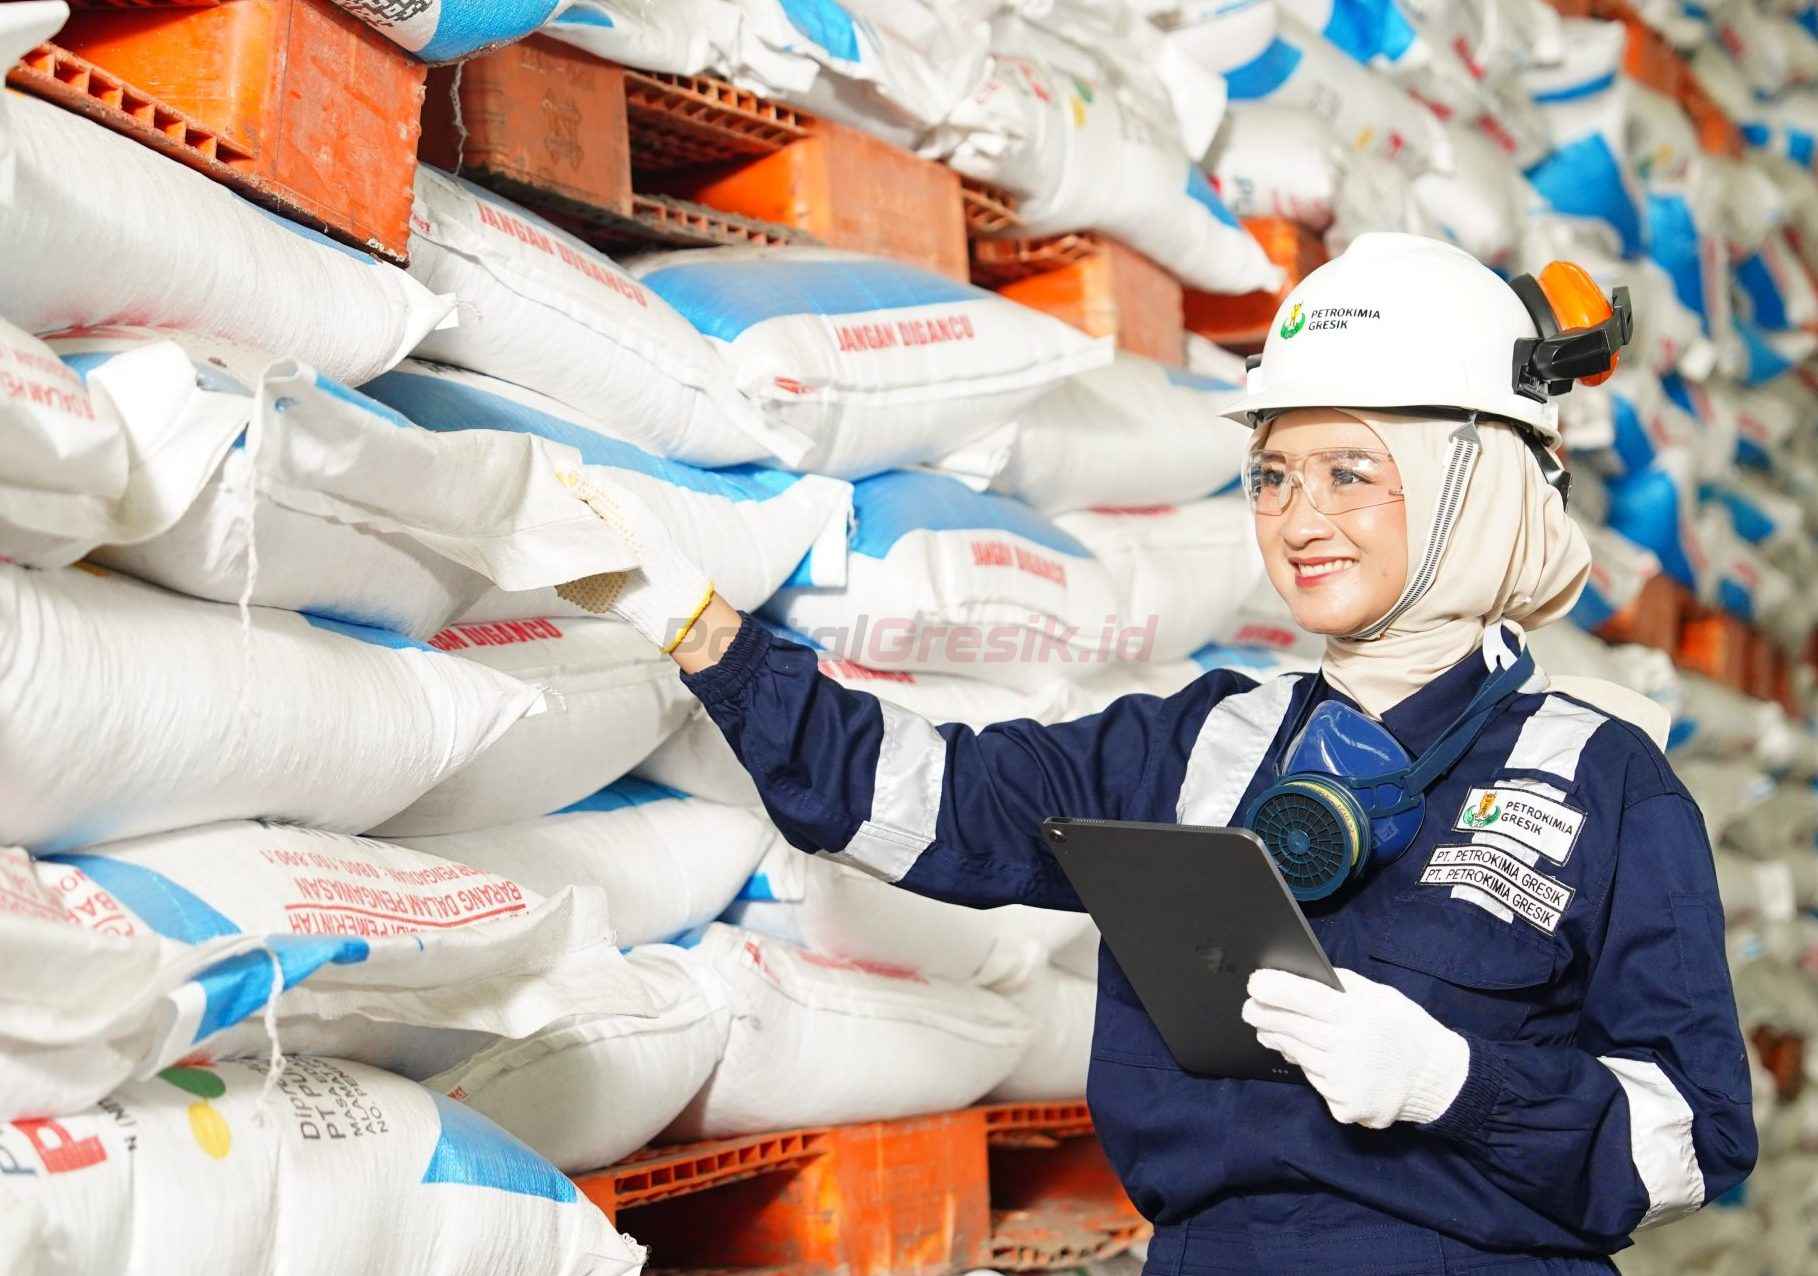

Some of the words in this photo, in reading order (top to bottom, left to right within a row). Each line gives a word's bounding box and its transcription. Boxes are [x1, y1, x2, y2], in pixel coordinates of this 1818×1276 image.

[1308, 320, 1348, 331] GRESIK
[1311, 308, 1381, 319] PETROKIMIA
[835, 324, 898, 351] JANGAN
[898, 315, 975, 347] DIGANCU
[457, 617, 562, 646] DIGANCU
[1501, 813, 1543, 836] GRESIK
[1506, 801, 1573, 836] PETROKIMIA
[1436, 851, 1451, 862] PT.
[1456, 850, 1521, 882] PETROKIMIA
[1522, 873, 1566, 906] GRESIK
[293, 877, 406, 916] PENGAWASAN
[407, 894, 460, 921] DALAM
[463, 879, 523, 912] BARANG
[1426, 869, 1442, 881] PT.
[1446, 869, 1511, 901] PETROKIMIA
[1512, 893, 1556, 927] GRESIK
[316, 1105, 347, 1140] PT
